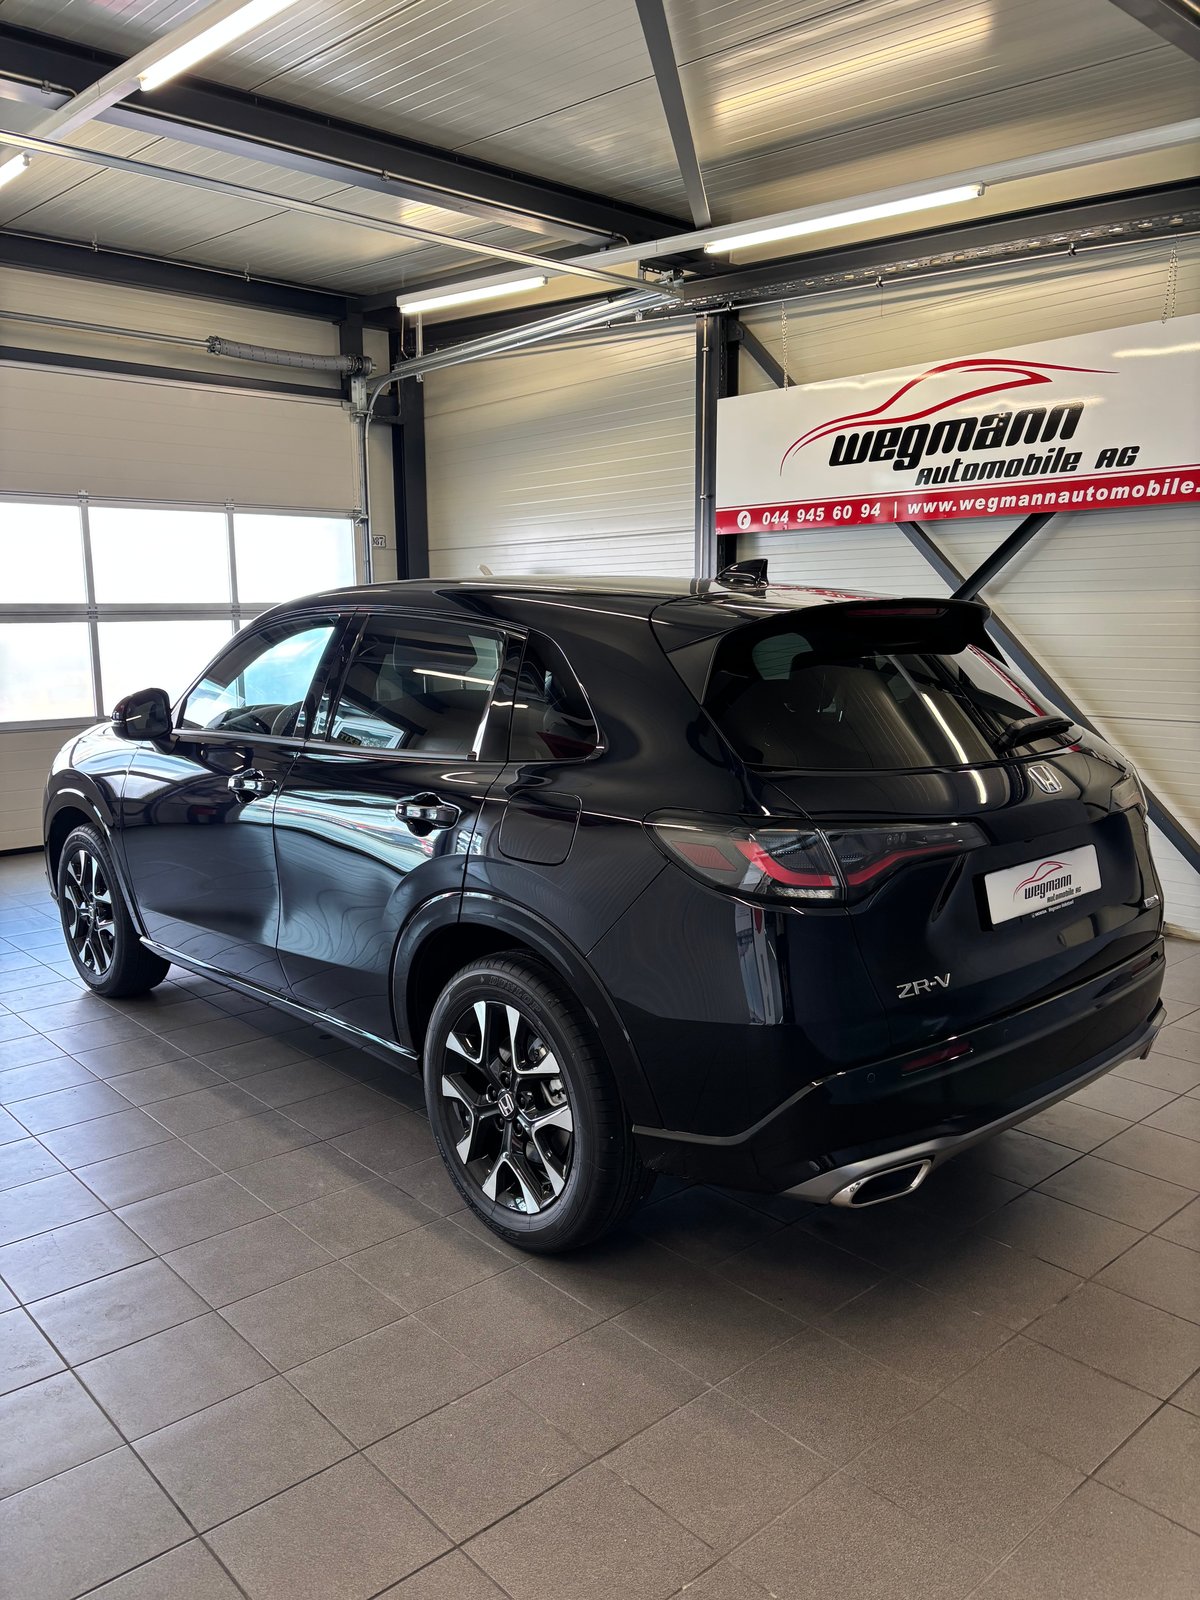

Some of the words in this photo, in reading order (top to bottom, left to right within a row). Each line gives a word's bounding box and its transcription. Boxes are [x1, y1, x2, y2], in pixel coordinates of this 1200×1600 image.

[829, 402, 1085, 471] wegmann
[915, 446, 1082, 486] automobile
[1094, 445, 1140, 469] AG
[762, 508, 789, 526] 044
[797, 506, 825, 523] 945
[832, 504, 853, 520] 60
[861, 502, 881, 518] 94
[1024, 874, 1072, 900] wegmann
[1047, 887, 1075, 903] automobile
[488, 975, 542, 1013] DUNLOP
[896, 973, 950, 999] ZR-V
